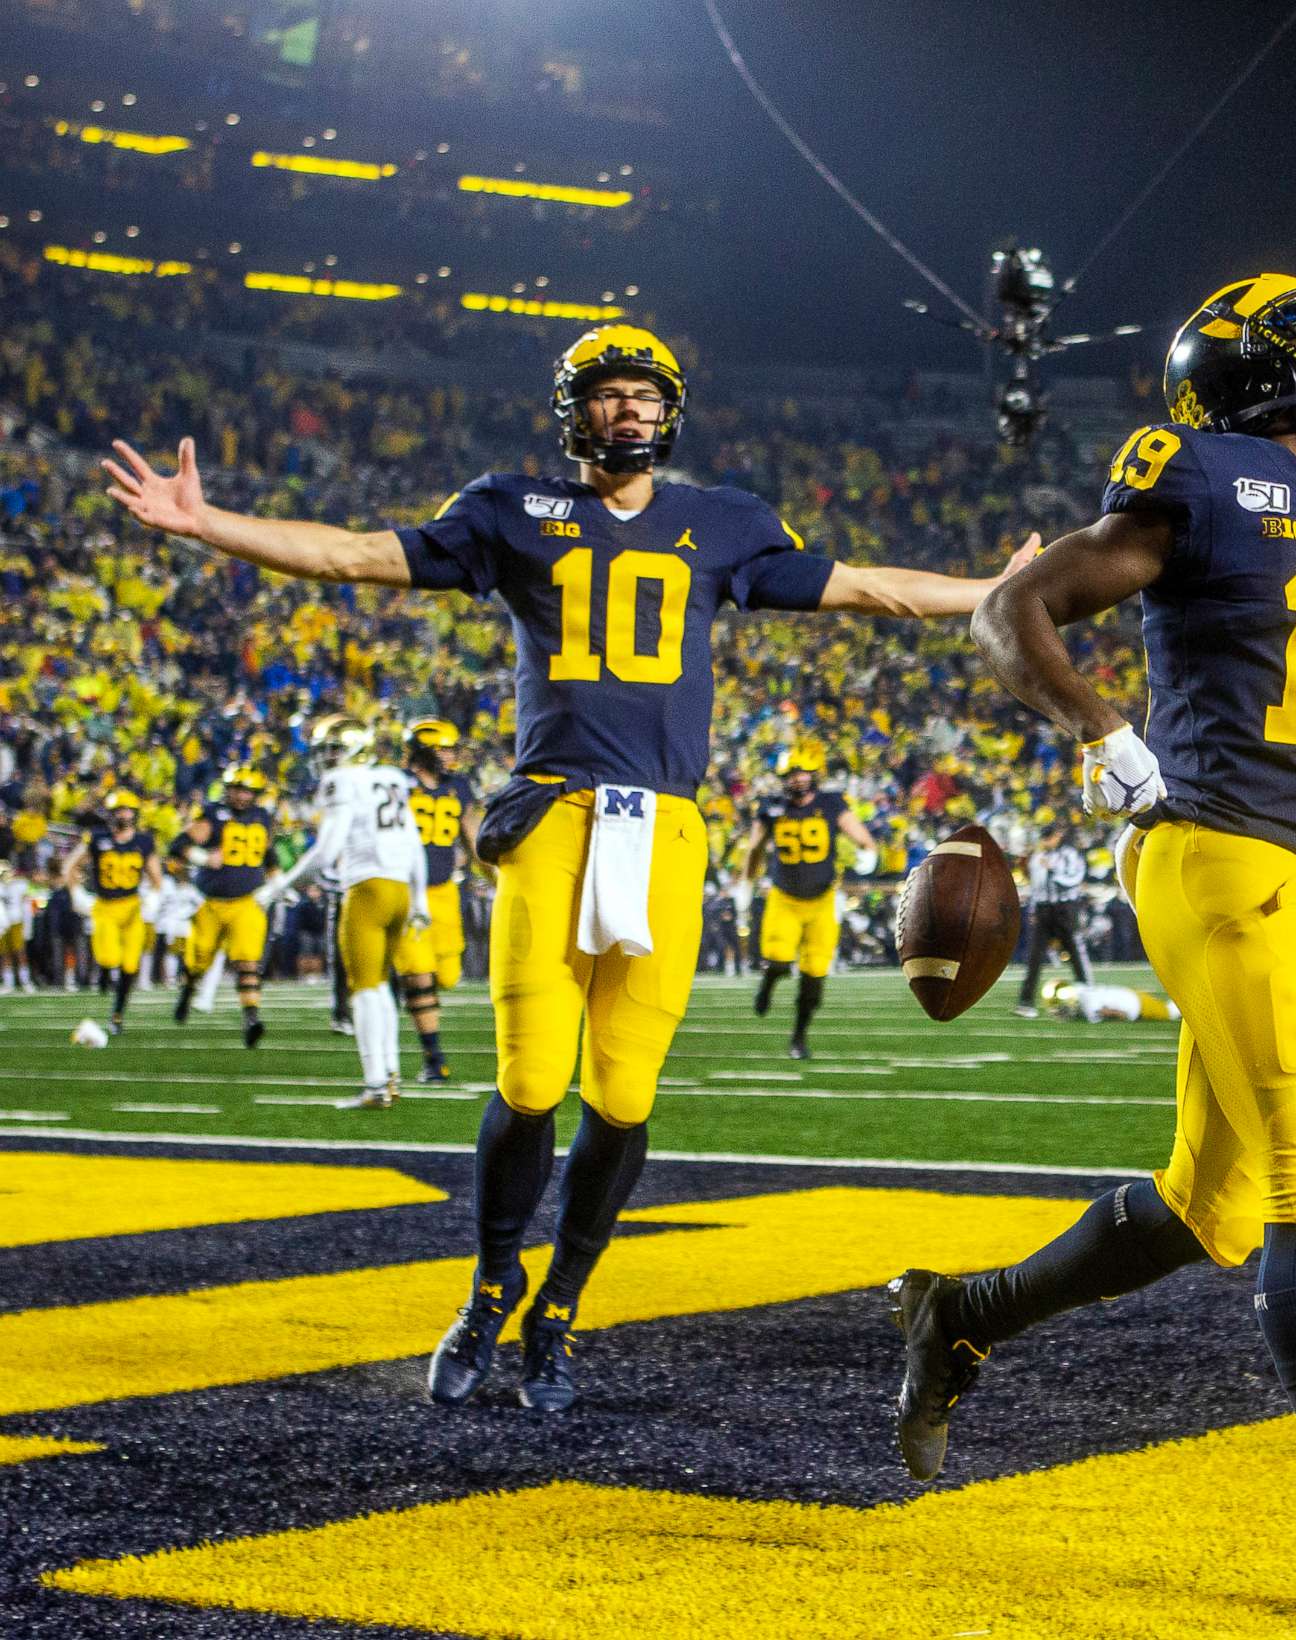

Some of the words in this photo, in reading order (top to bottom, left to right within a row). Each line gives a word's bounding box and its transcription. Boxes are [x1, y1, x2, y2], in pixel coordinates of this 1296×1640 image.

[1109, 425, 1182, 491] 19
[1237, 479, 1290, 513] 150
[548, 546, 691, 685] 10
[604, 788, 644, 818] M
[774, 816, 831, 865] 59
[479, 1280, 504, 1299] M
[543, 1302, 572, 1322] M
